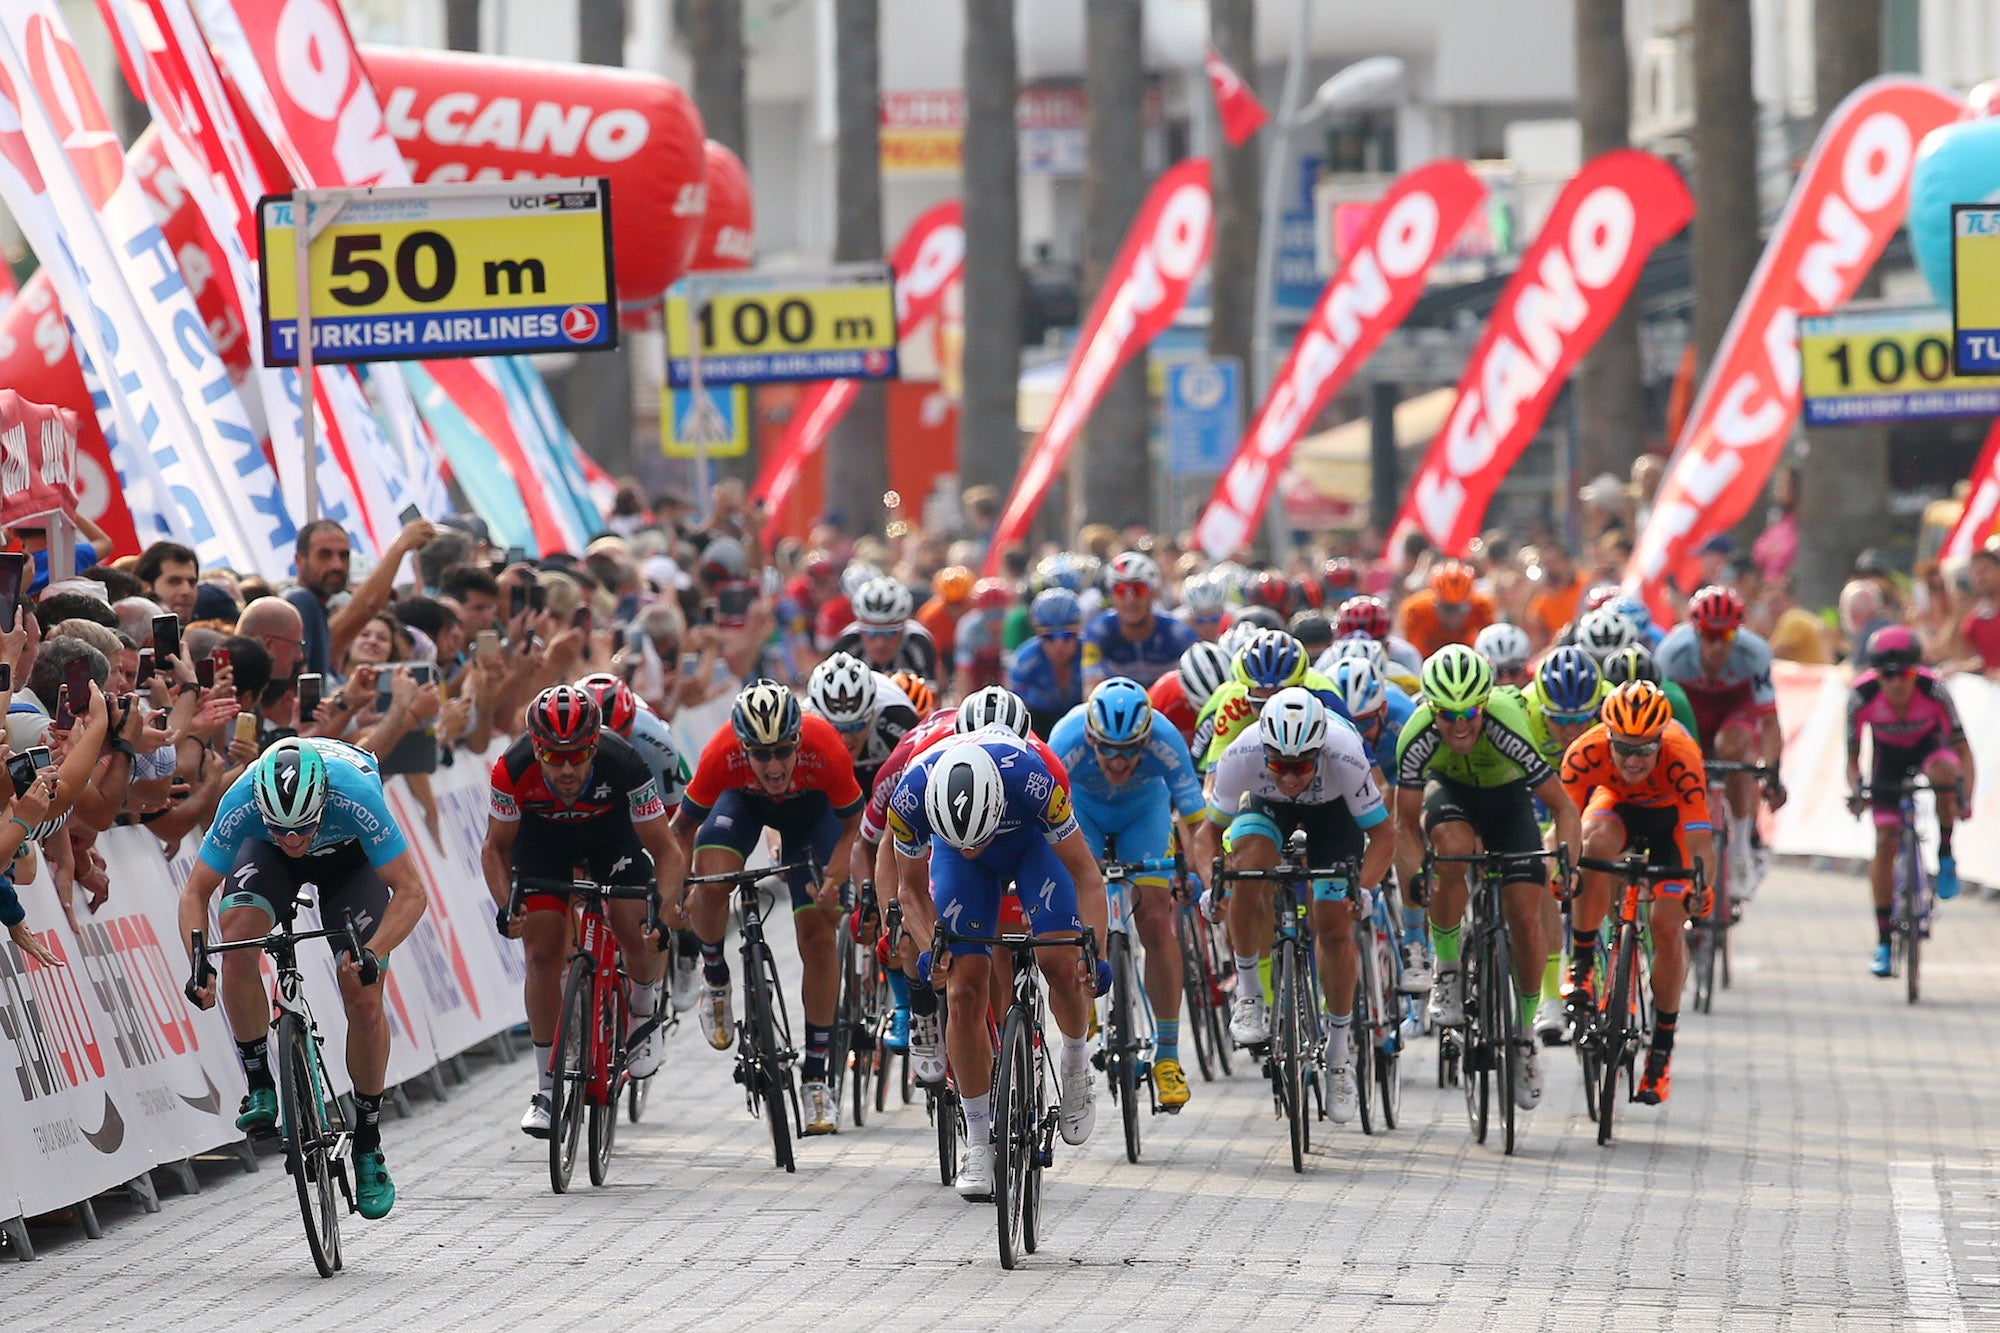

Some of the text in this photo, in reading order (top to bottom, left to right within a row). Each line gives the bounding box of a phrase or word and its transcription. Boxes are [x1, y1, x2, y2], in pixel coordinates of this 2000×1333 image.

[384, 87, 650, 162] LCANO
[510, 197, 539, 210] UCI
[329, 231, 546, 307] 50 m
[422, 313, 558, 344] AIRLINES
[697, 299, 874, 348] 100 m
[1400, 186, 1635, 550] LCANO
[1828, 338, 1950, 386] 100
[1401, 728, 1441, 780] MURIA
[1024, 781, 1048, 801] PRO
[1029, 771, 1050, 787] crivit
[1667, 761, 1706, 804] CCC
[220, 799, 258, 839] SPORTO
[327, 793, 380, 832] PORTOTO
[584, 918, 596, 951] BMC
